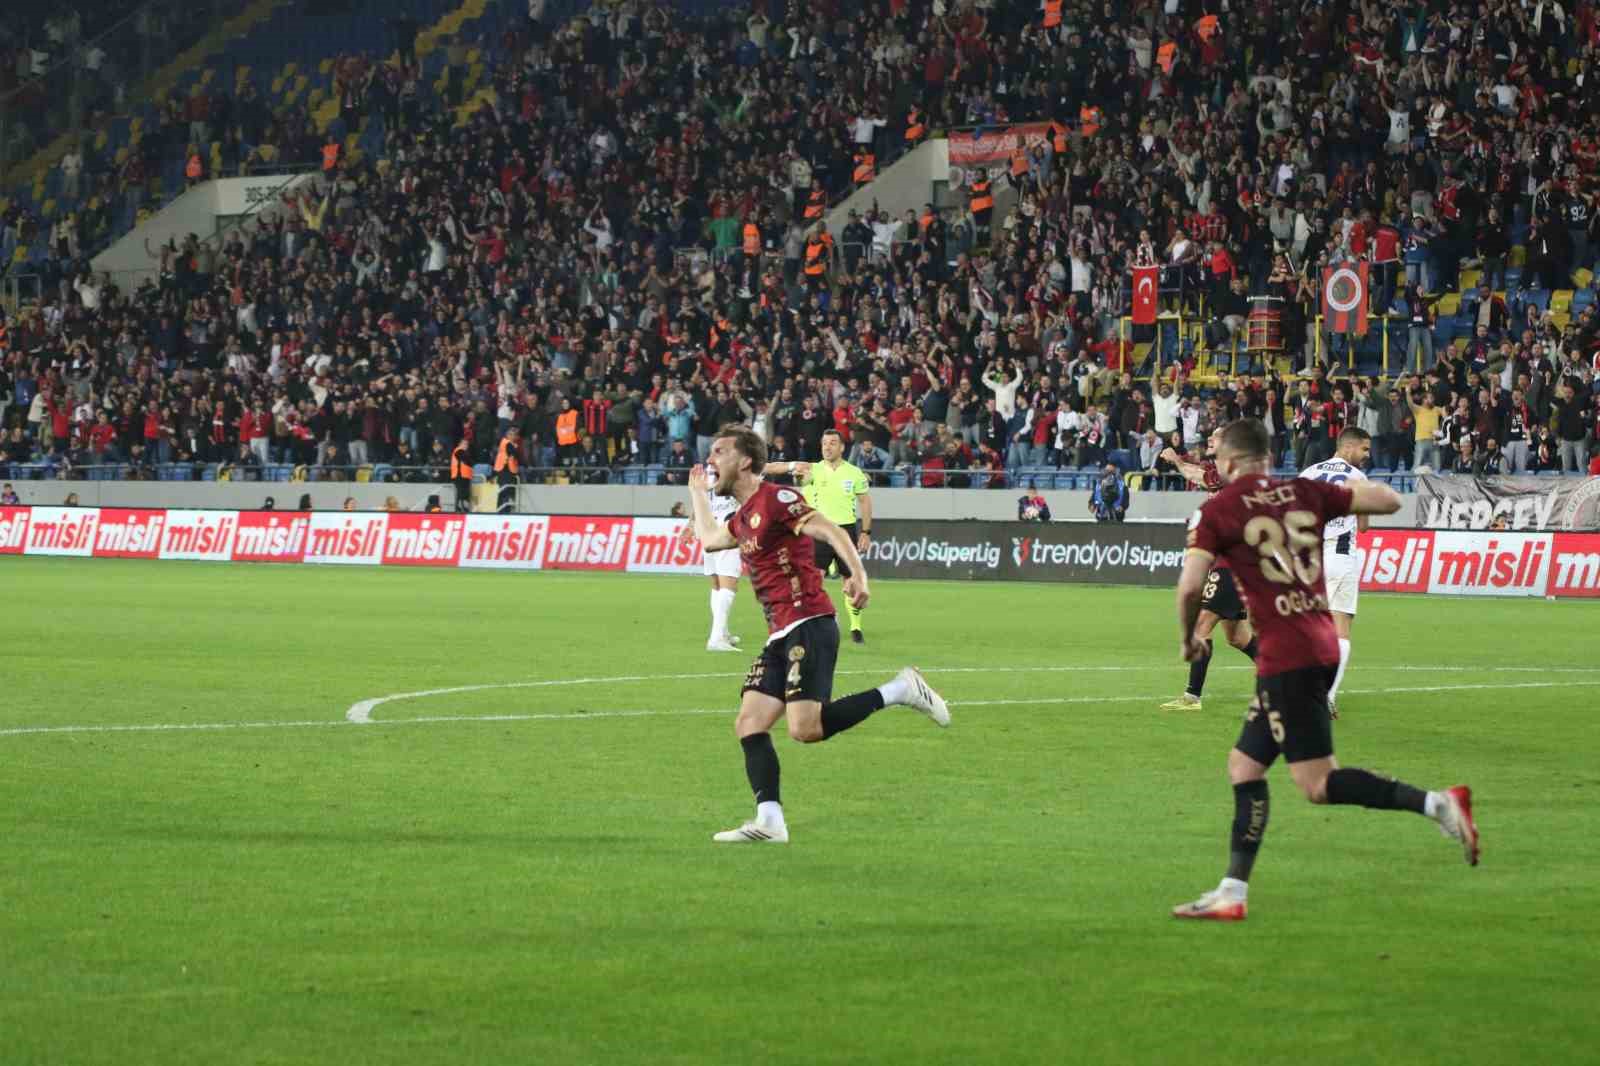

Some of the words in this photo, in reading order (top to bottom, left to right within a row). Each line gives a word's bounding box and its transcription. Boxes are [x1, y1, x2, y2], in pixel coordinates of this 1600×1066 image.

[1571, 205, 1587, 221] 92
[0, 512, 29, 547] sli
[31, 513, 96, 549] misli
[99, 515, 164, 552] misli
[166, 517, 231, 553] misli
[237, 518, 306, 556] misli
[311, 519, 382, 557] misli
[386, 519, 463, 560] misli
[467, 523, 542, 562] misli
[546, 524, 630, 565] misli
[1438, 540, 1545, 588] misli
[787, 661, 802, 686] 4
